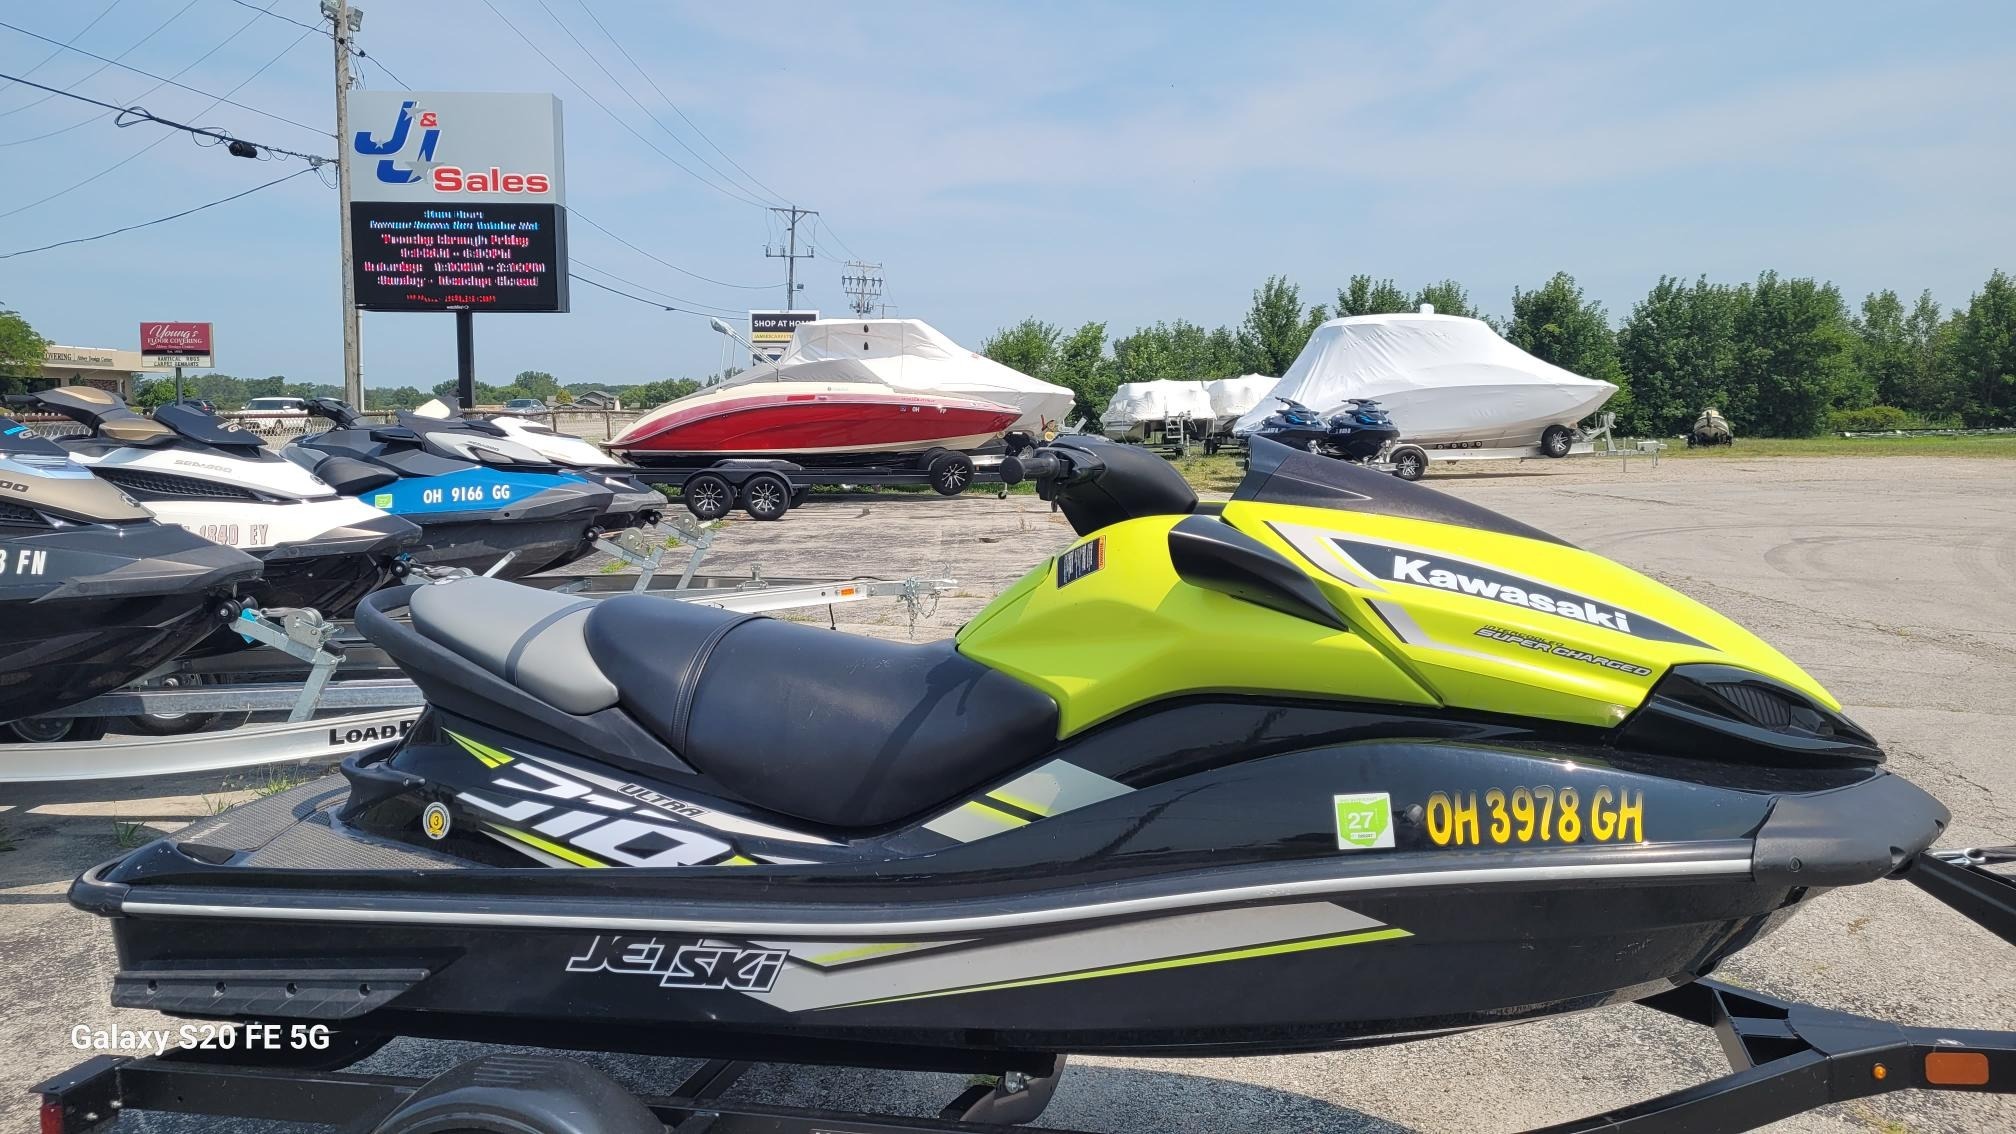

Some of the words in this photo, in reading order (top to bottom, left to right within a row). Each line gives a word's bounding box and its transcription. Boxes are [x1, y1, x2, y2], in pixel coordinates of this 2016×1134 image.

[420, 113, 437, 127] &
[434, 168, 549, 193] Sales
[149, 325, 199, 343] Young's
[423, 488, 442, 504] OH
[452, 486, 483, 502] 9166
[492, 484, 511, 500] GG
[250, 524, 268, 545] EY
[16, 550, 47, 575] FN
[1393, 554, 1631, 633] Kawasaki
[1484, 624, 1564, 647] INTERCOOLED
[1475, 628, 1552, 652] SUPER
[1552, 646, 1652, 677] CHARGED
[618, 783, 705, 818] ULTRA
[1348, 811, 1374, 829] 27
[1427, 790, 1480, 845] OH
[1486, 785, 1580, 843] 3978
[1591, 784, 1645, 843] GH
